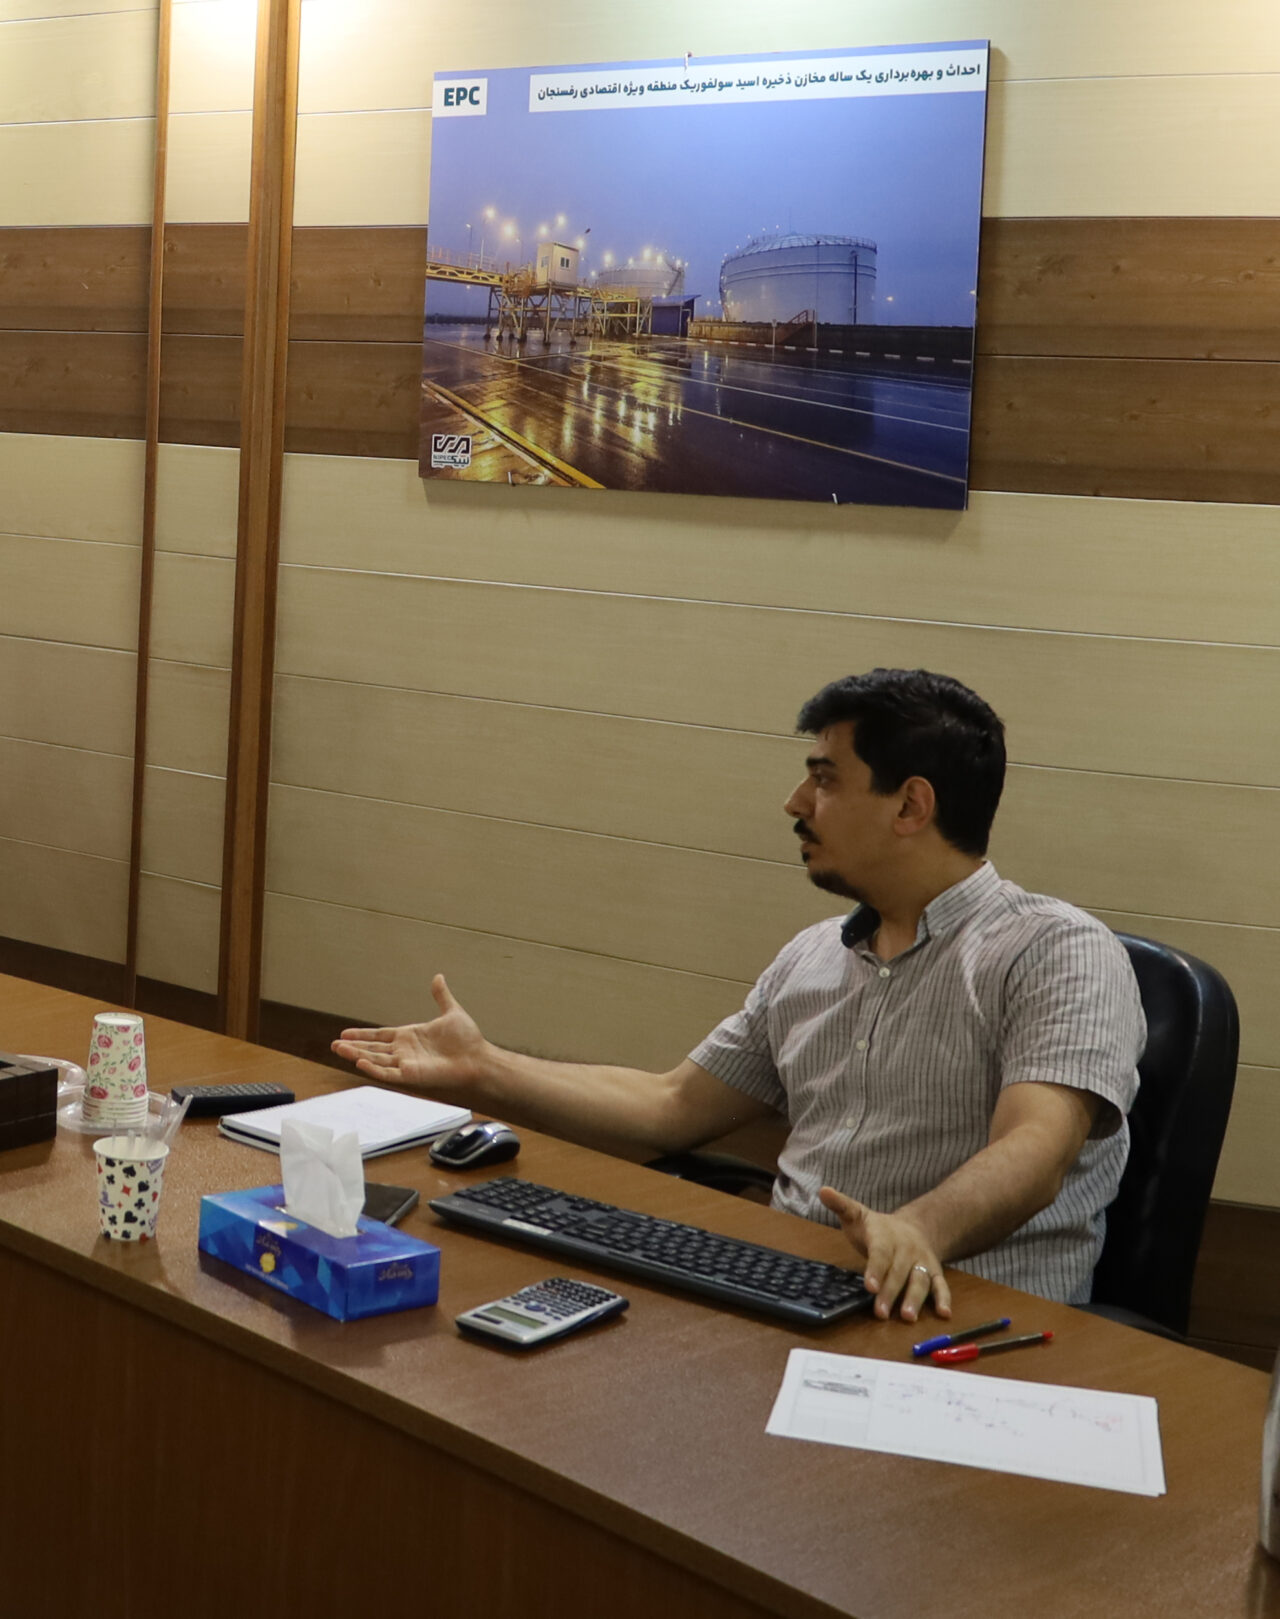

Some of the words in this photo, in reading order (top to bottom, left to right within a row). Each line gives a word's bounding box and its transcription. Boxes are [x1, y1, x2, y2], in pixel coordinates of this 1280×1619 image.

[829, 71, 853, 82] ساله
[855, 69, 872, 83] یک
[936, 69, 943, 80] و
[946, 64, 980, 76] احداث
[647, 80, 677, 91] منطقه
[680, 77, 733, 93] سولفوریک
[736, 75, 759, 90] اسید
[762, 72, 792, 89] ذخیره
[794, 72, 826, 87] مخازن
[538, 85, 578, 100] رفسنجان
[580, 82, 621, 98] اقتصادی
[623, 81, 644, 96] ویژه
[443, 86, 480, 107] EPC
